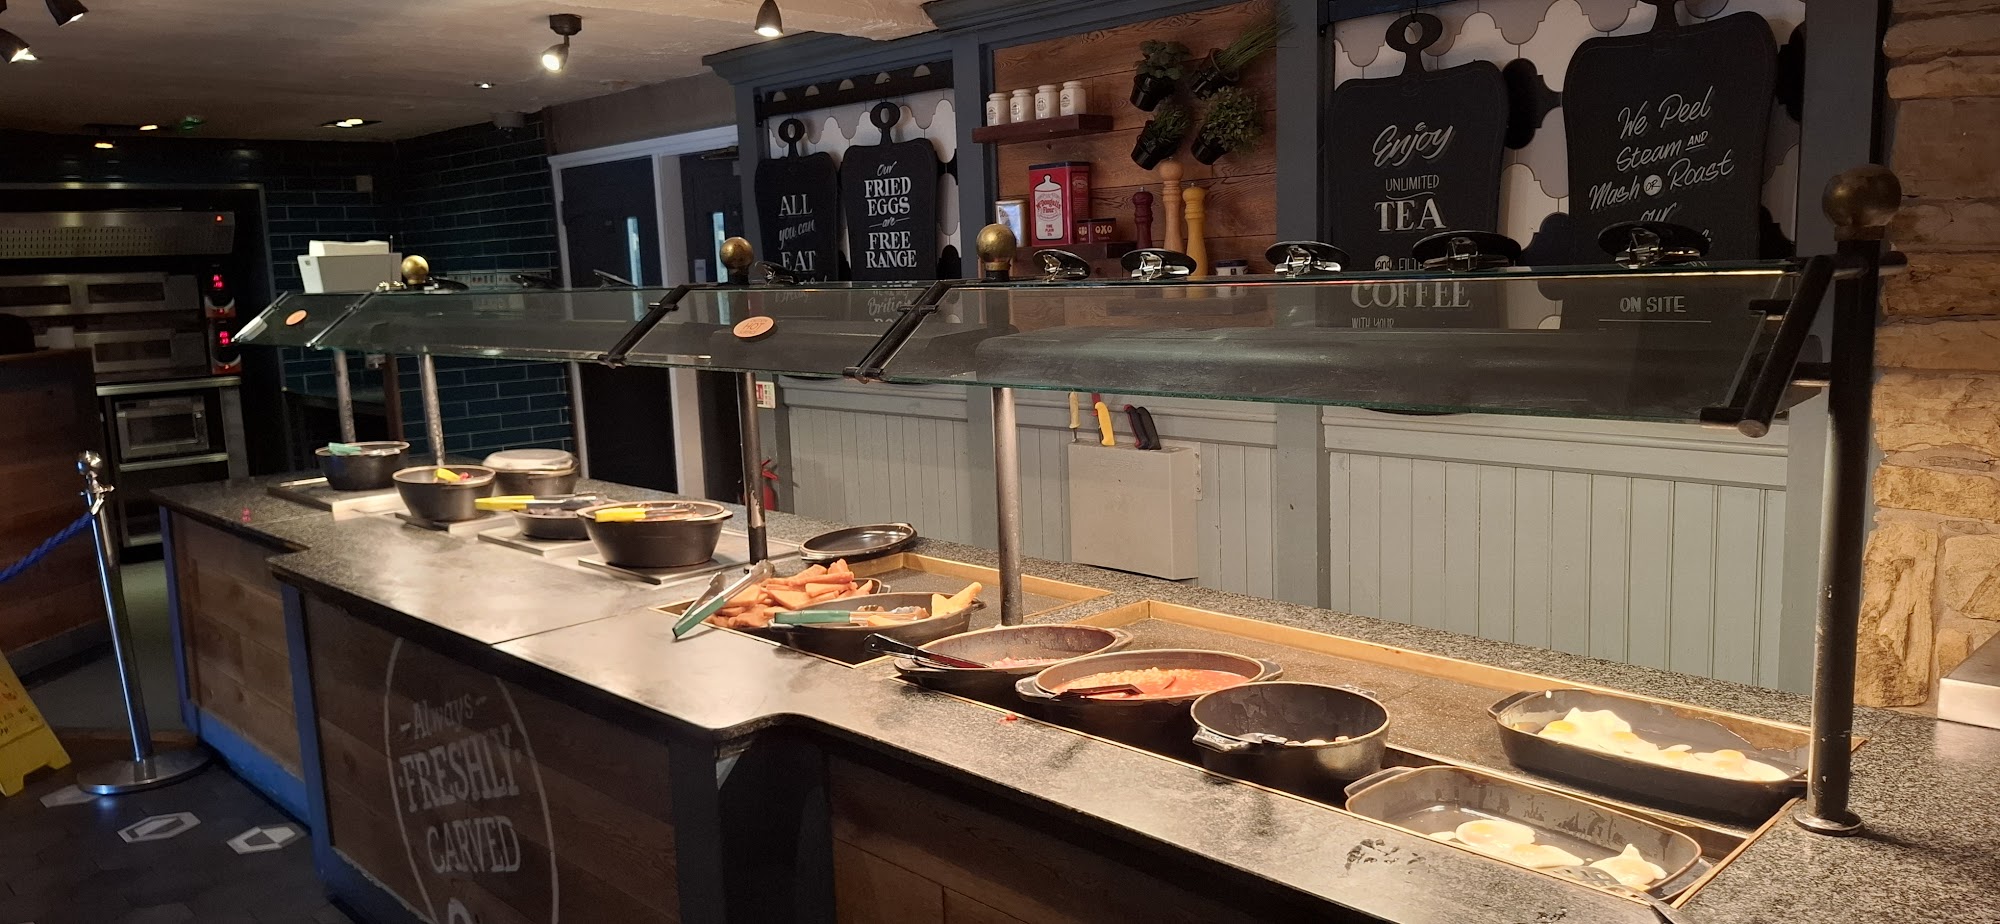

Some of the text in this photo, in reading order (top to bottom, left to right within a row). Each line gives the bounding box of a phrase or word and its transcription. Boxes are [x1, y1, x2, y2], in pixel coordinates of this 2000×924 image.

[1617, 85, 1714, 140] We Peel
[1372, 121, 1454, 167] Enjoy
[1616, 130, 1709, 172] Steam AND
[876, 161, 898, 177] Our
[1588, 149, 1735, 211] Mash OR Roast
[864, 176, 912, 198] FRIED
[1385, 174, 1440, 192] UNLIMITED
[778, 194, 813, 216] ALL
[867, 196, 911, 217] EGGS
[1374, 198, 1447, 232] TEA
[882, 217, 897, 228] are
[1095, 225, 1113, 235] OXO
[778, 219, 816, 249] you can
[868, 231, 912, 250] FREE
[781, 250, 816, 272] EAT
[866, 250, 918, 269] RANGE
[1351, 281, 1471, 309] COFFEE
[1619, 295, 1687, 313] ON SITE
[743, 322, 765, 330] HOT
[413, 693, 474, 740] Always
[400, 723, 520, 813] FRESHLY
[426, 815, 521, 875] CARVED
